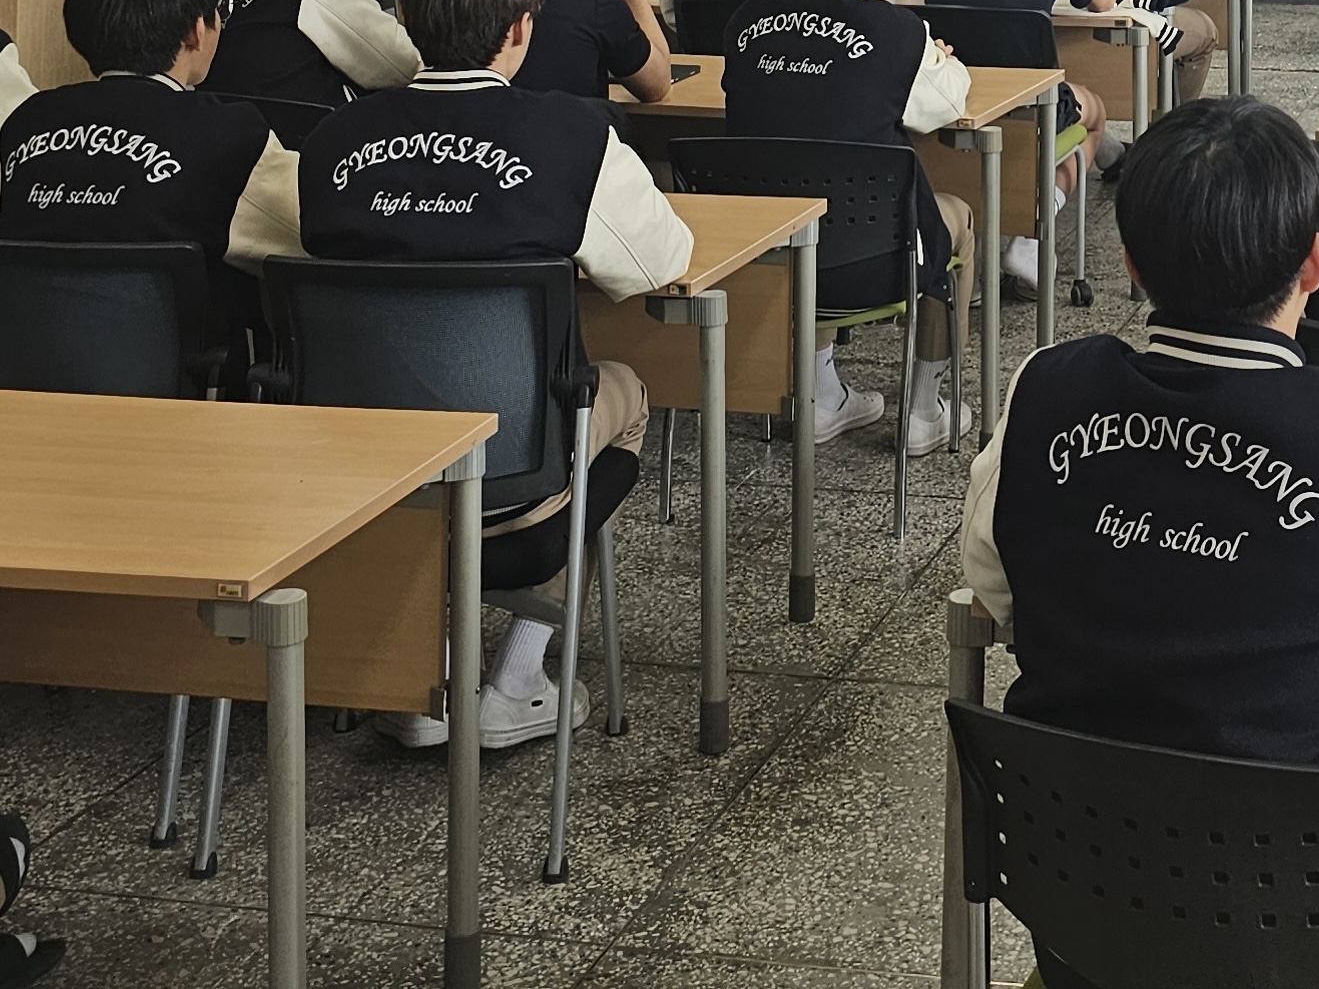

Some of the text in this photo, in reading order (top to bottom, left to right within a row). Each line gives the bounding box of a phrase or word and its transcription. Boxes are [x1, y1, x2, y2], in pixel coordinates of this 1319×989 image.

[737, 11, 874, 59] GYEONGSANG
[756, 53, 834, 75] high school
[5, 123, 182, 183] GYEONGSANG
[332, 131, 534, 191] GYEONGSANG
[27, 183, 126, 209] high school
[370, 190, 480, 217] high school
[1094, 503, 1249, 562] high school
